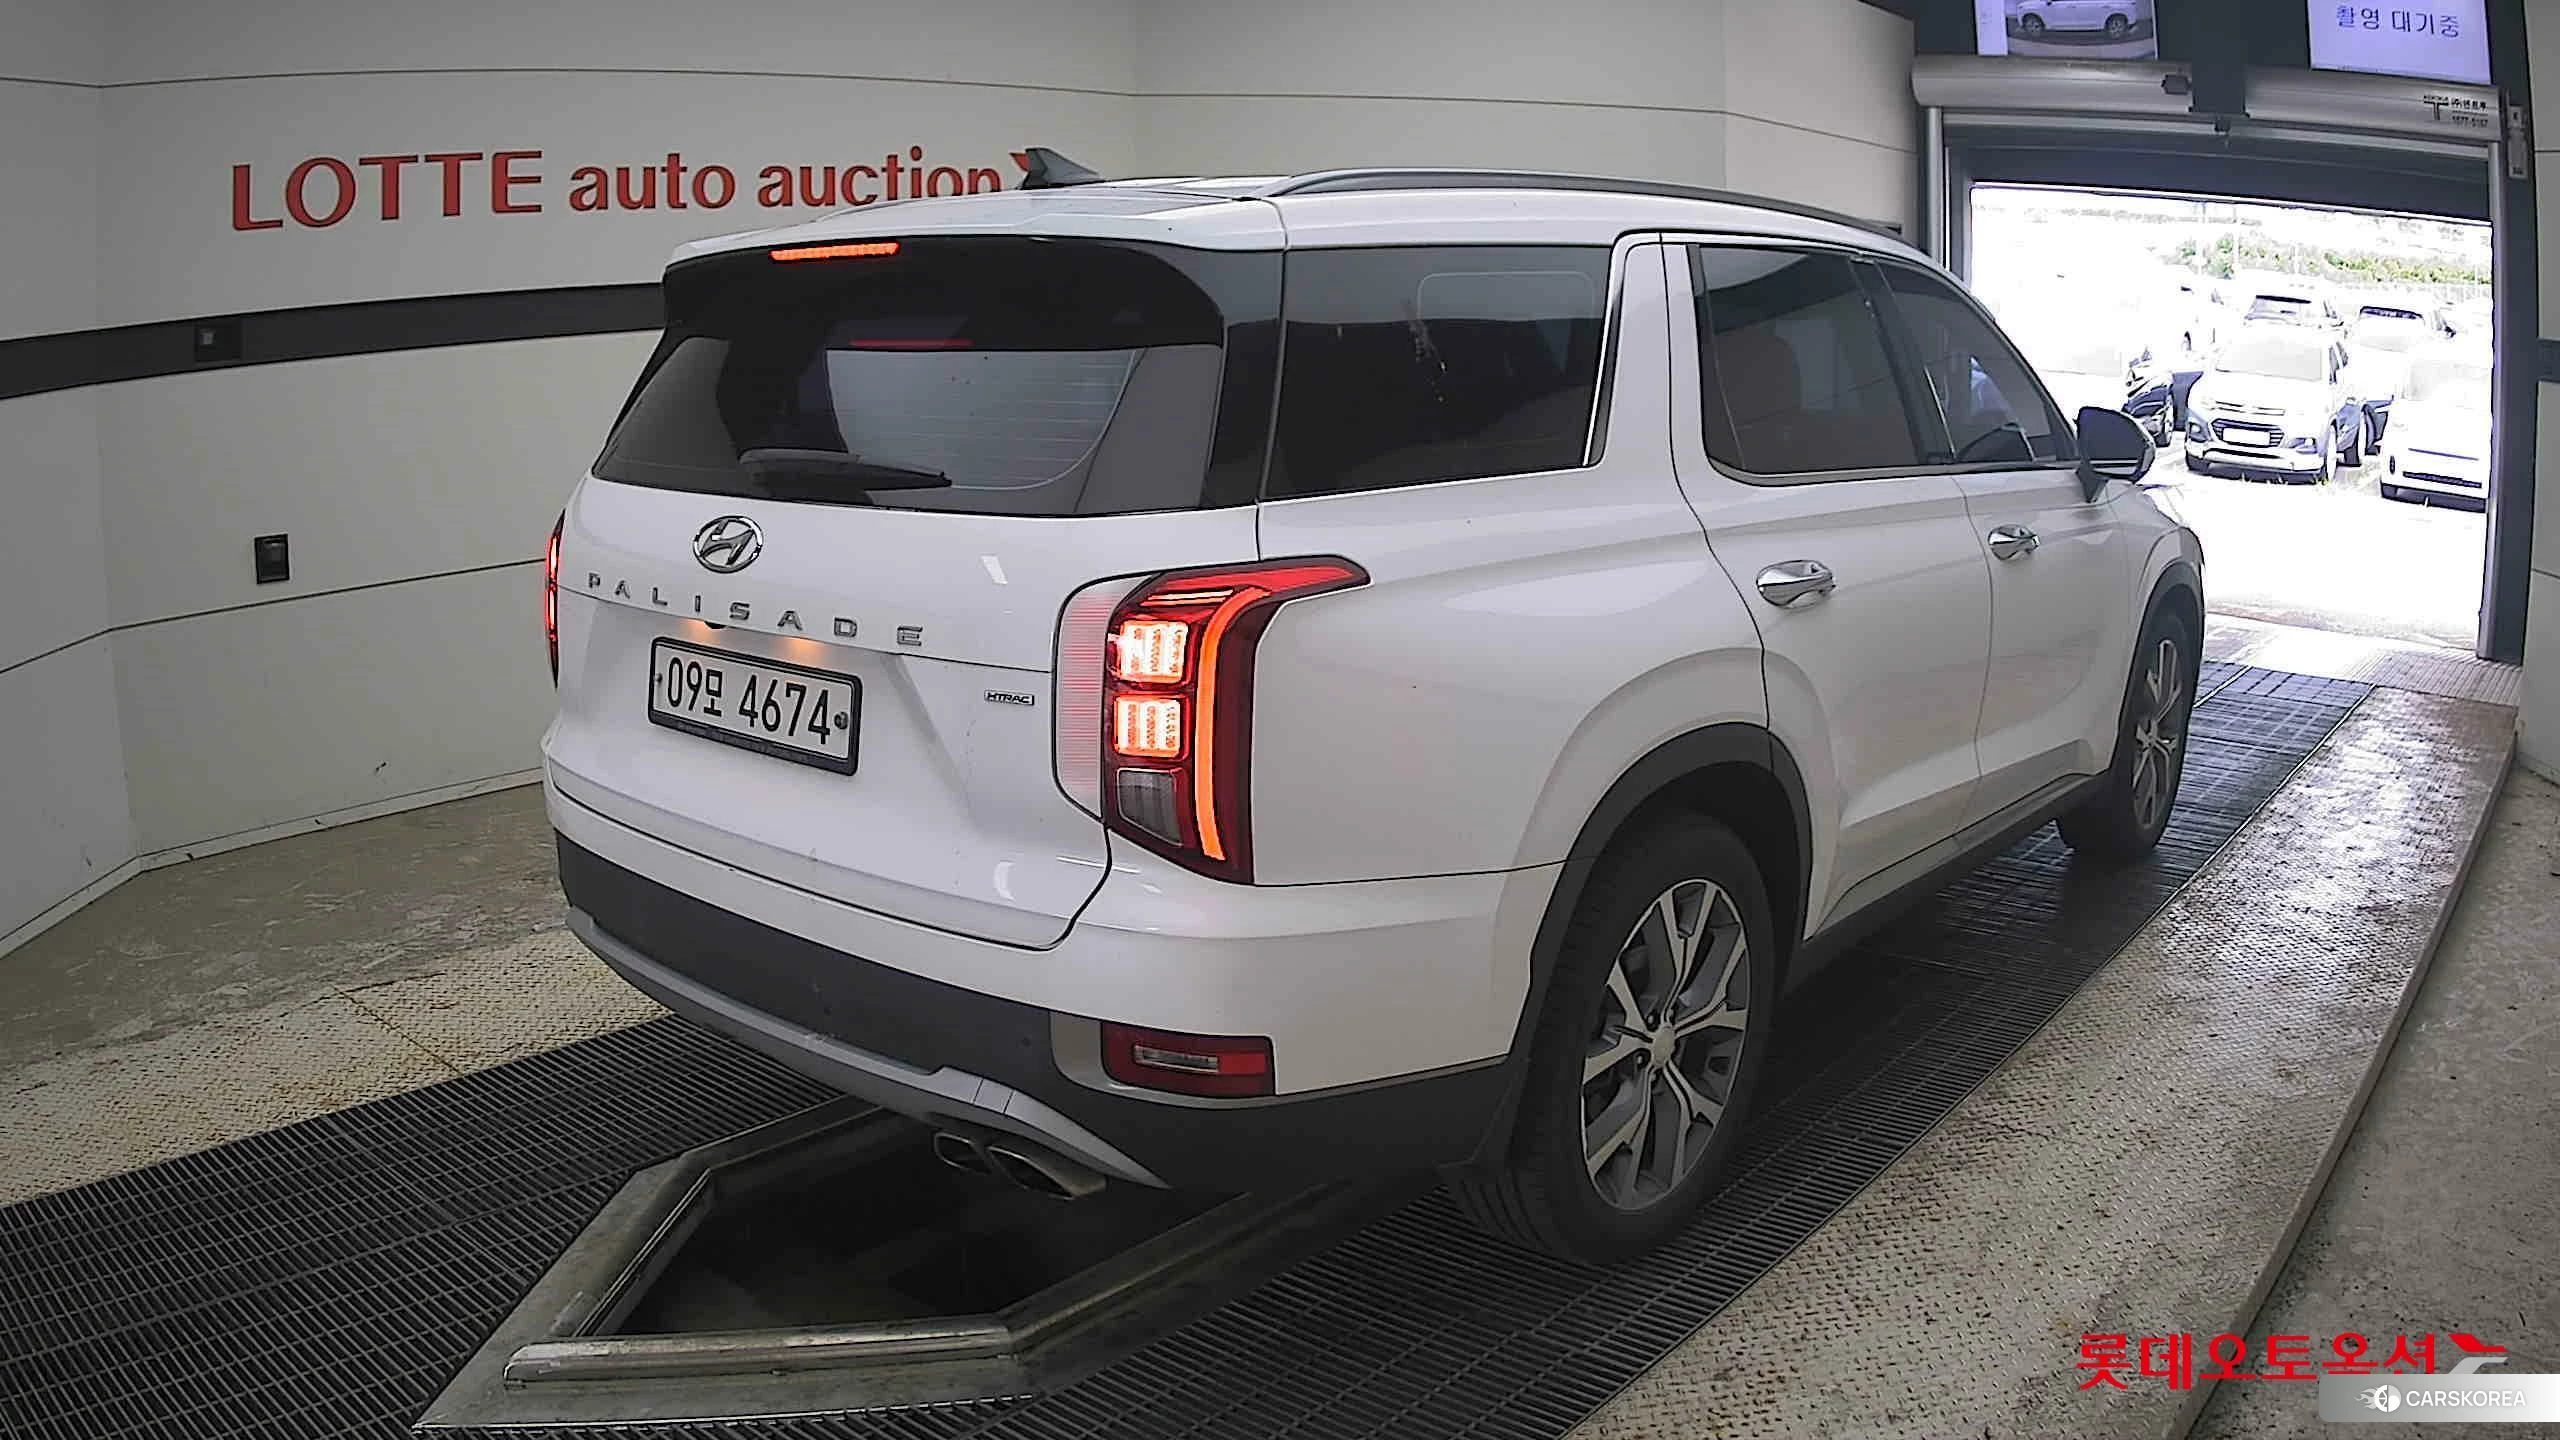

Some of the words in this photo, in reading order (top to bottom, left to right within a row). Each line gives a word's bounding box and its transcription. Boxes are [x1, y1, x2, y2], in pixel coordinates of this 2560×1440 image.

[2391, 7, 2460, 38] 대기중
[232, 150, 542, 231] LOTTE
[568, 152, 736, 211] auto
[757, 145, 1001, 207] auction
[587, 571, 925, 647] PALISADE
[667, 656, 723, 717] 09모
[738, 674, 831, 745] 4674
[987, 691, 1030, 704] HTRAC
